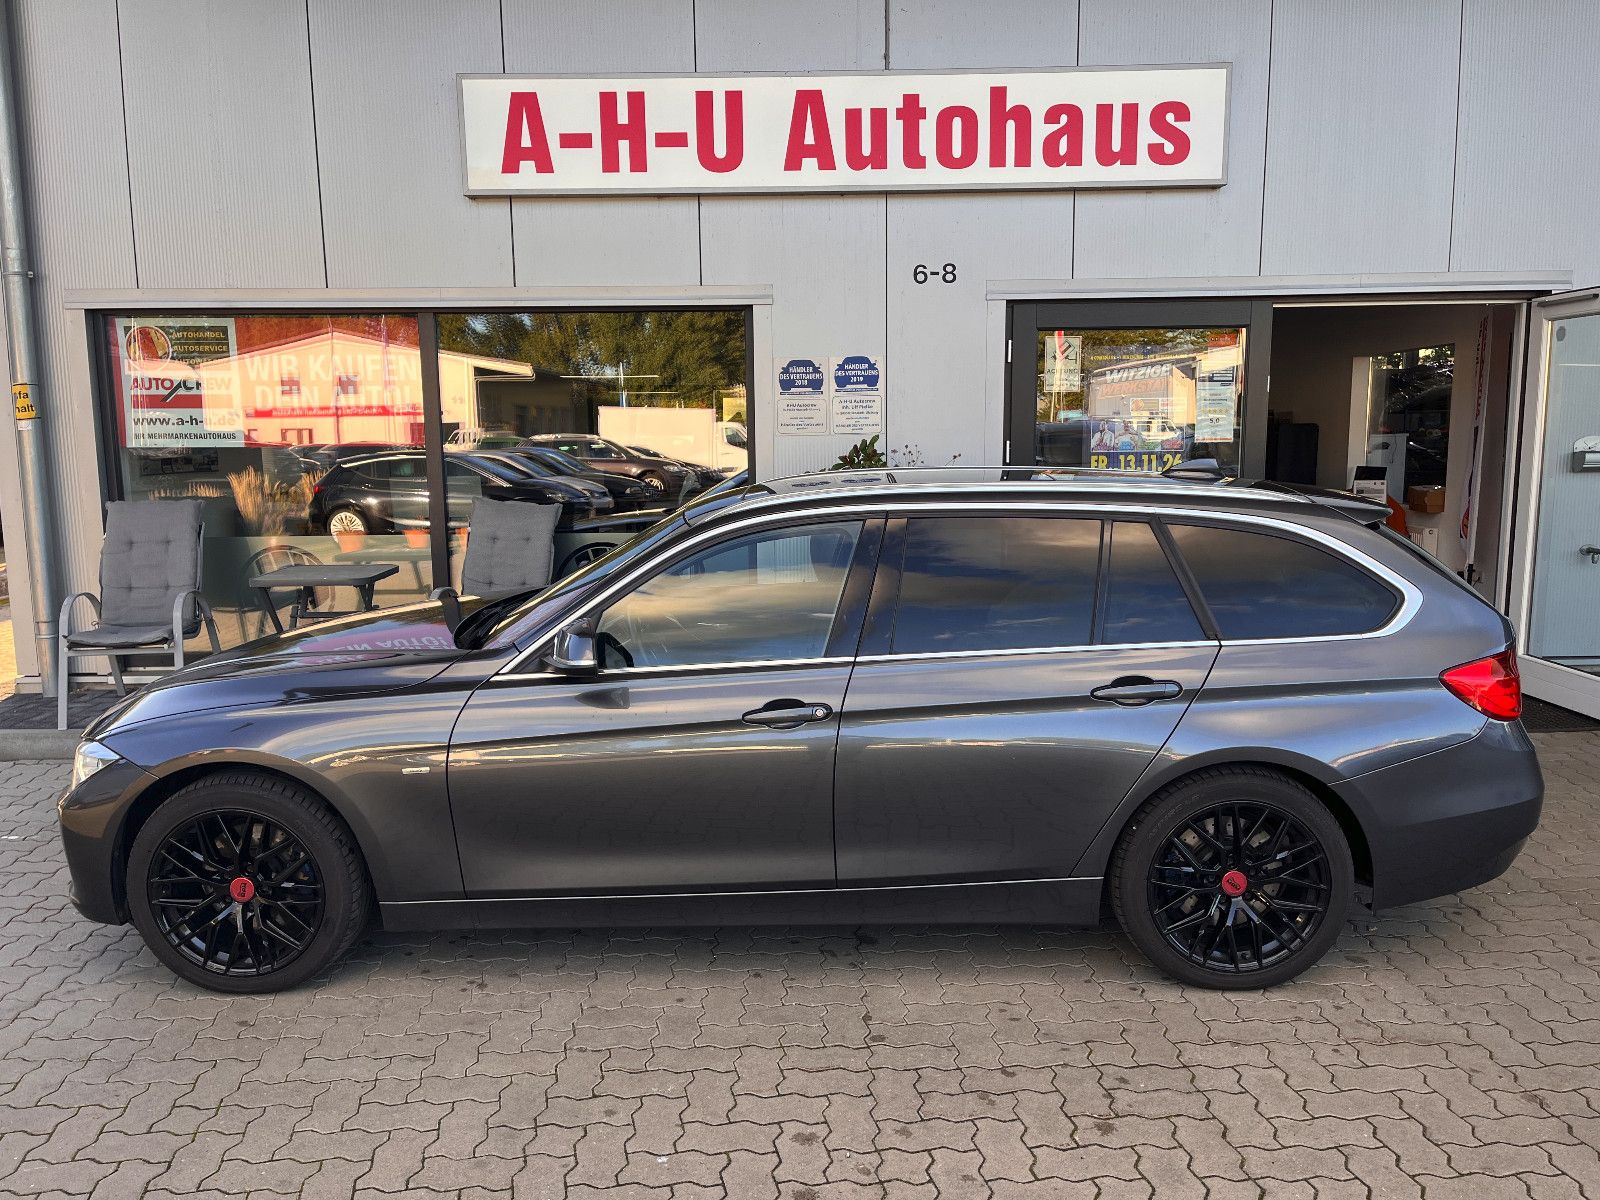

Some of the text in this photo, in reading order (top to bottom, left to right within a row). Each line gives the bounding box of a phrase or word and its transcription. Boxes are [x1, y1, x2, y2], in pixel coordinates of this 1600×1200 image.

[501, 85, 1192, 174] A-H-U Autohaus
[913, 263, 957, 284] 6-8
[172, 344, 228, 352] AUTOSERVICE
[245, 353, 417, 381] WIR KAUFEN
[255, 385, 320, 410] DEIN
[147, 432, 236, 440] MEHRMARKENAUTOHAUS
